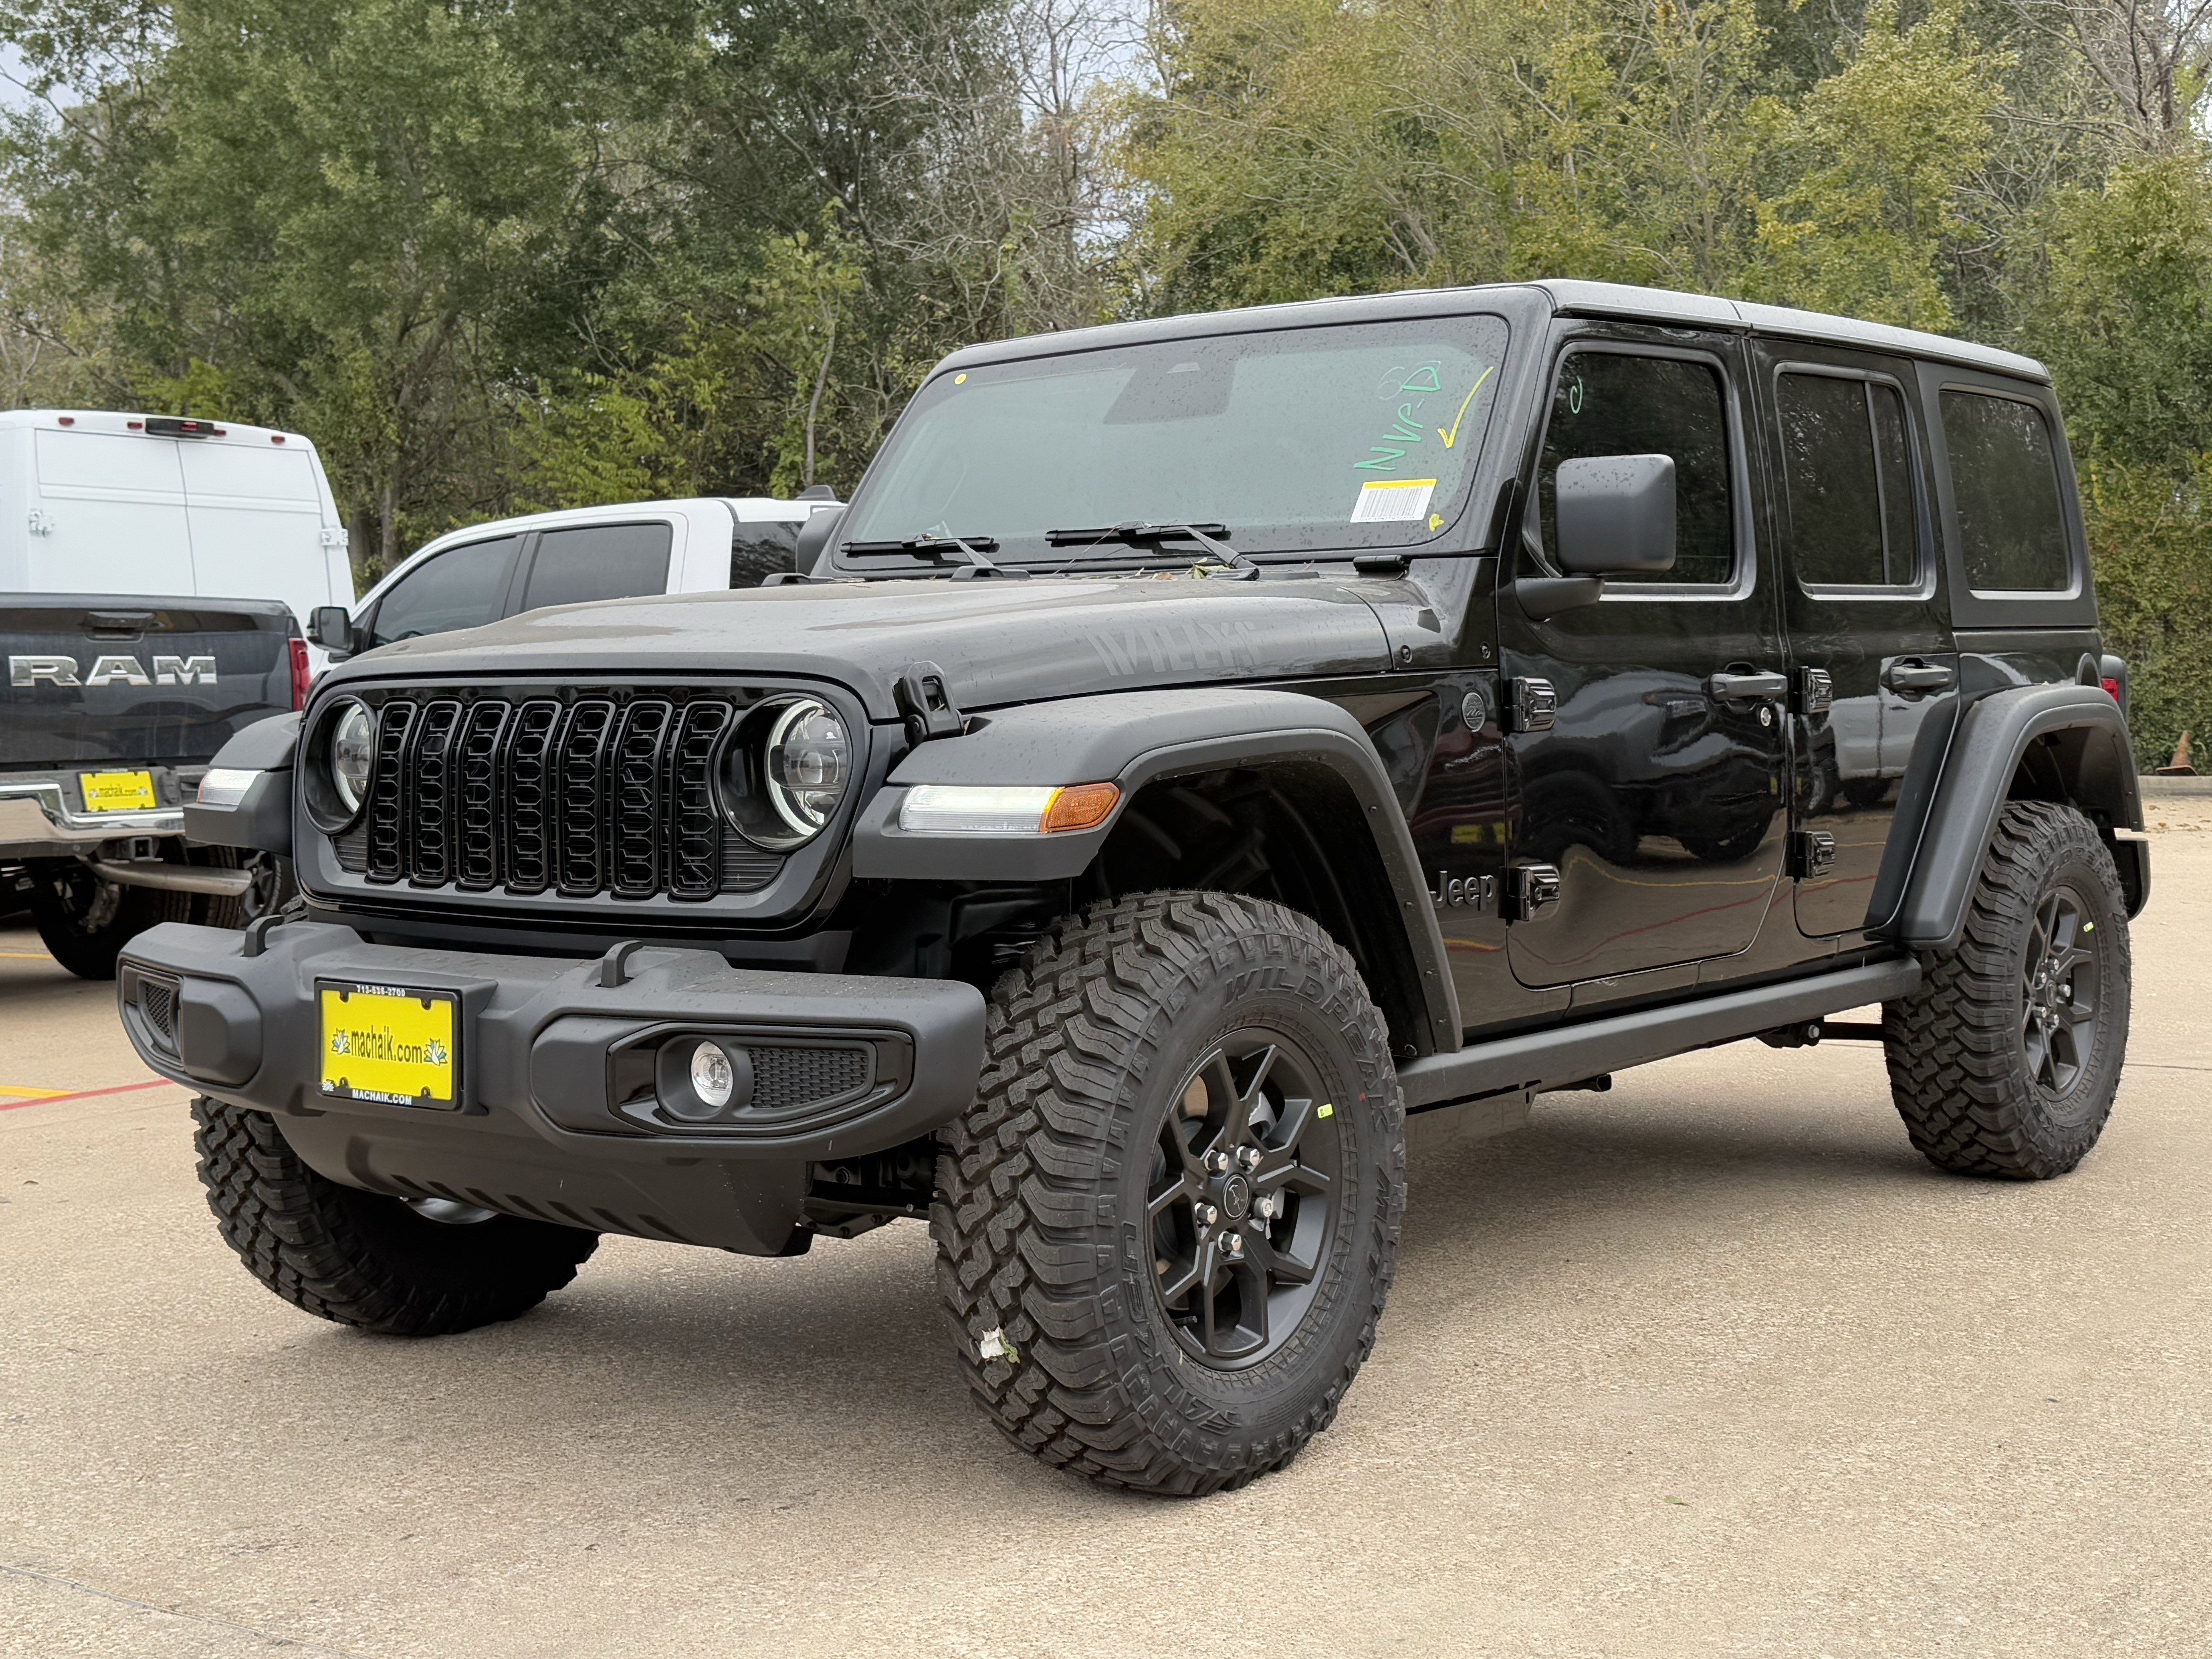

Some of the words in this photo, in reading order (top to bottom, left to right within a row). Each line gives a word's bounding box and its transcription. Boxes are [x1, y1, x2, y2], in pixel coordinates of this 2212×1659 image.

[9, 655, 218, 687] RAM
[1430, 871, 1495, 911] Jeep
[352, 1025, 422, 1063] machaik.com
[1223, 966, 1390, 1133] WILDPEAK
[352, 1091, 412, 1105] MACHAIK.COM
